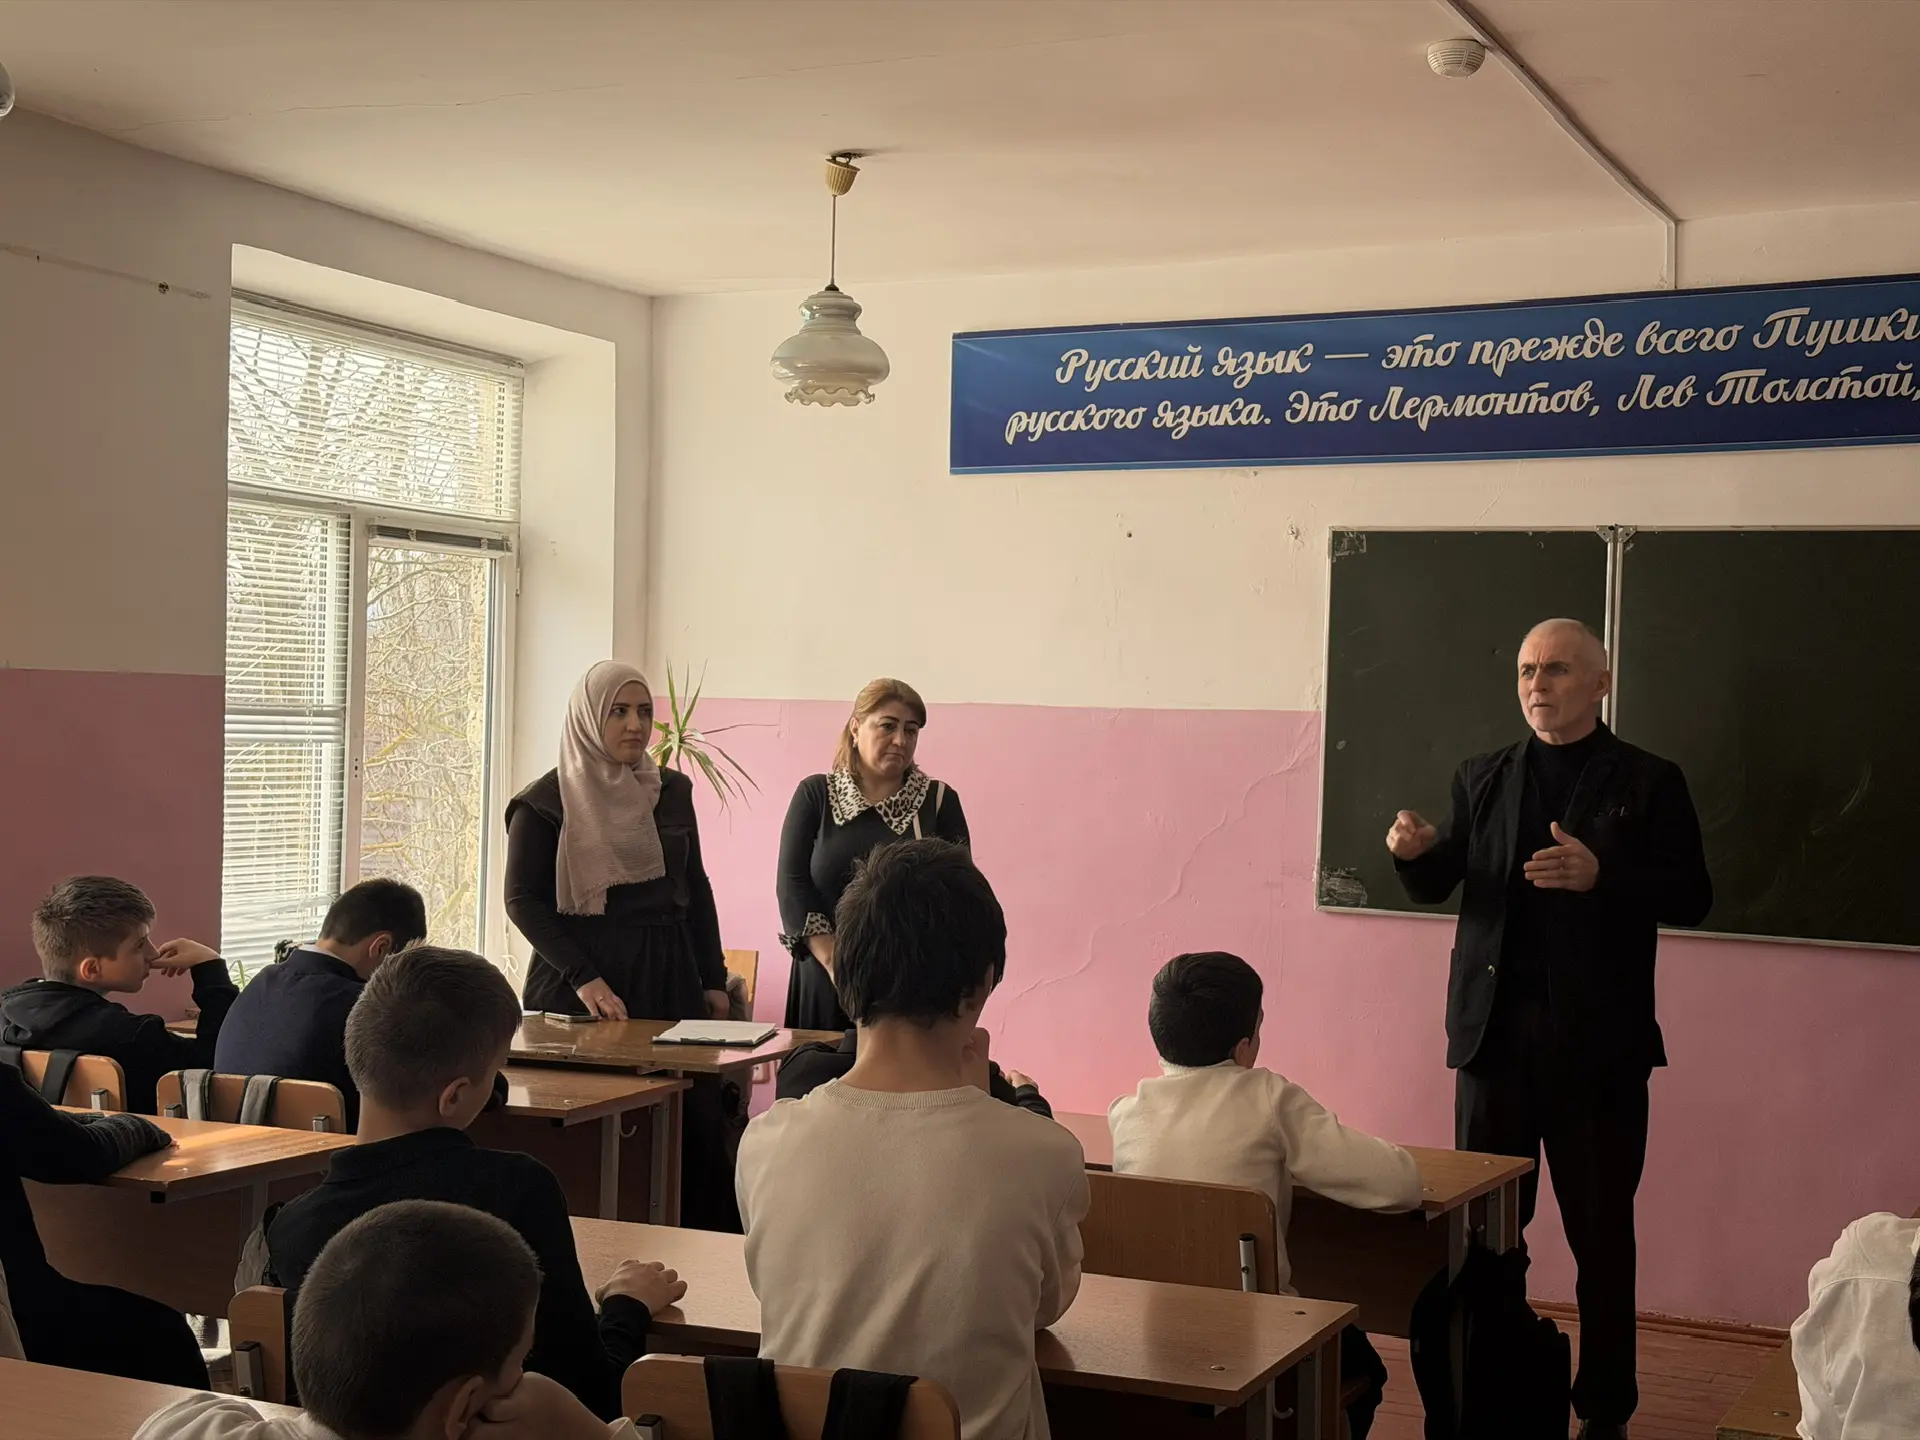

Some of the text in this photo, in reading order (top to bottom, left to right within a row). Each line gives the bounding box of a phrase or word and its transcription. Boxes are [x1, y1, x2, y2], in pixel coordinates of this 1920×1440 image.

[1055, 343, 1205, 393] Русский
[1211, 342, 1314, 389] язык
[1381, 333, 1462, 369] это
[1467, 317, 1625, 378] прежде
[1635, 320, 1745, 356] всего
[1004, 403, 1148, 446] русского
[1152, 397, 1272, 440] языка.
[1284, 390, 1363, 424] Это
[1368, 380, 1600, 432] Лермонтов,
[1617, 374, 1698, 412] Лев
